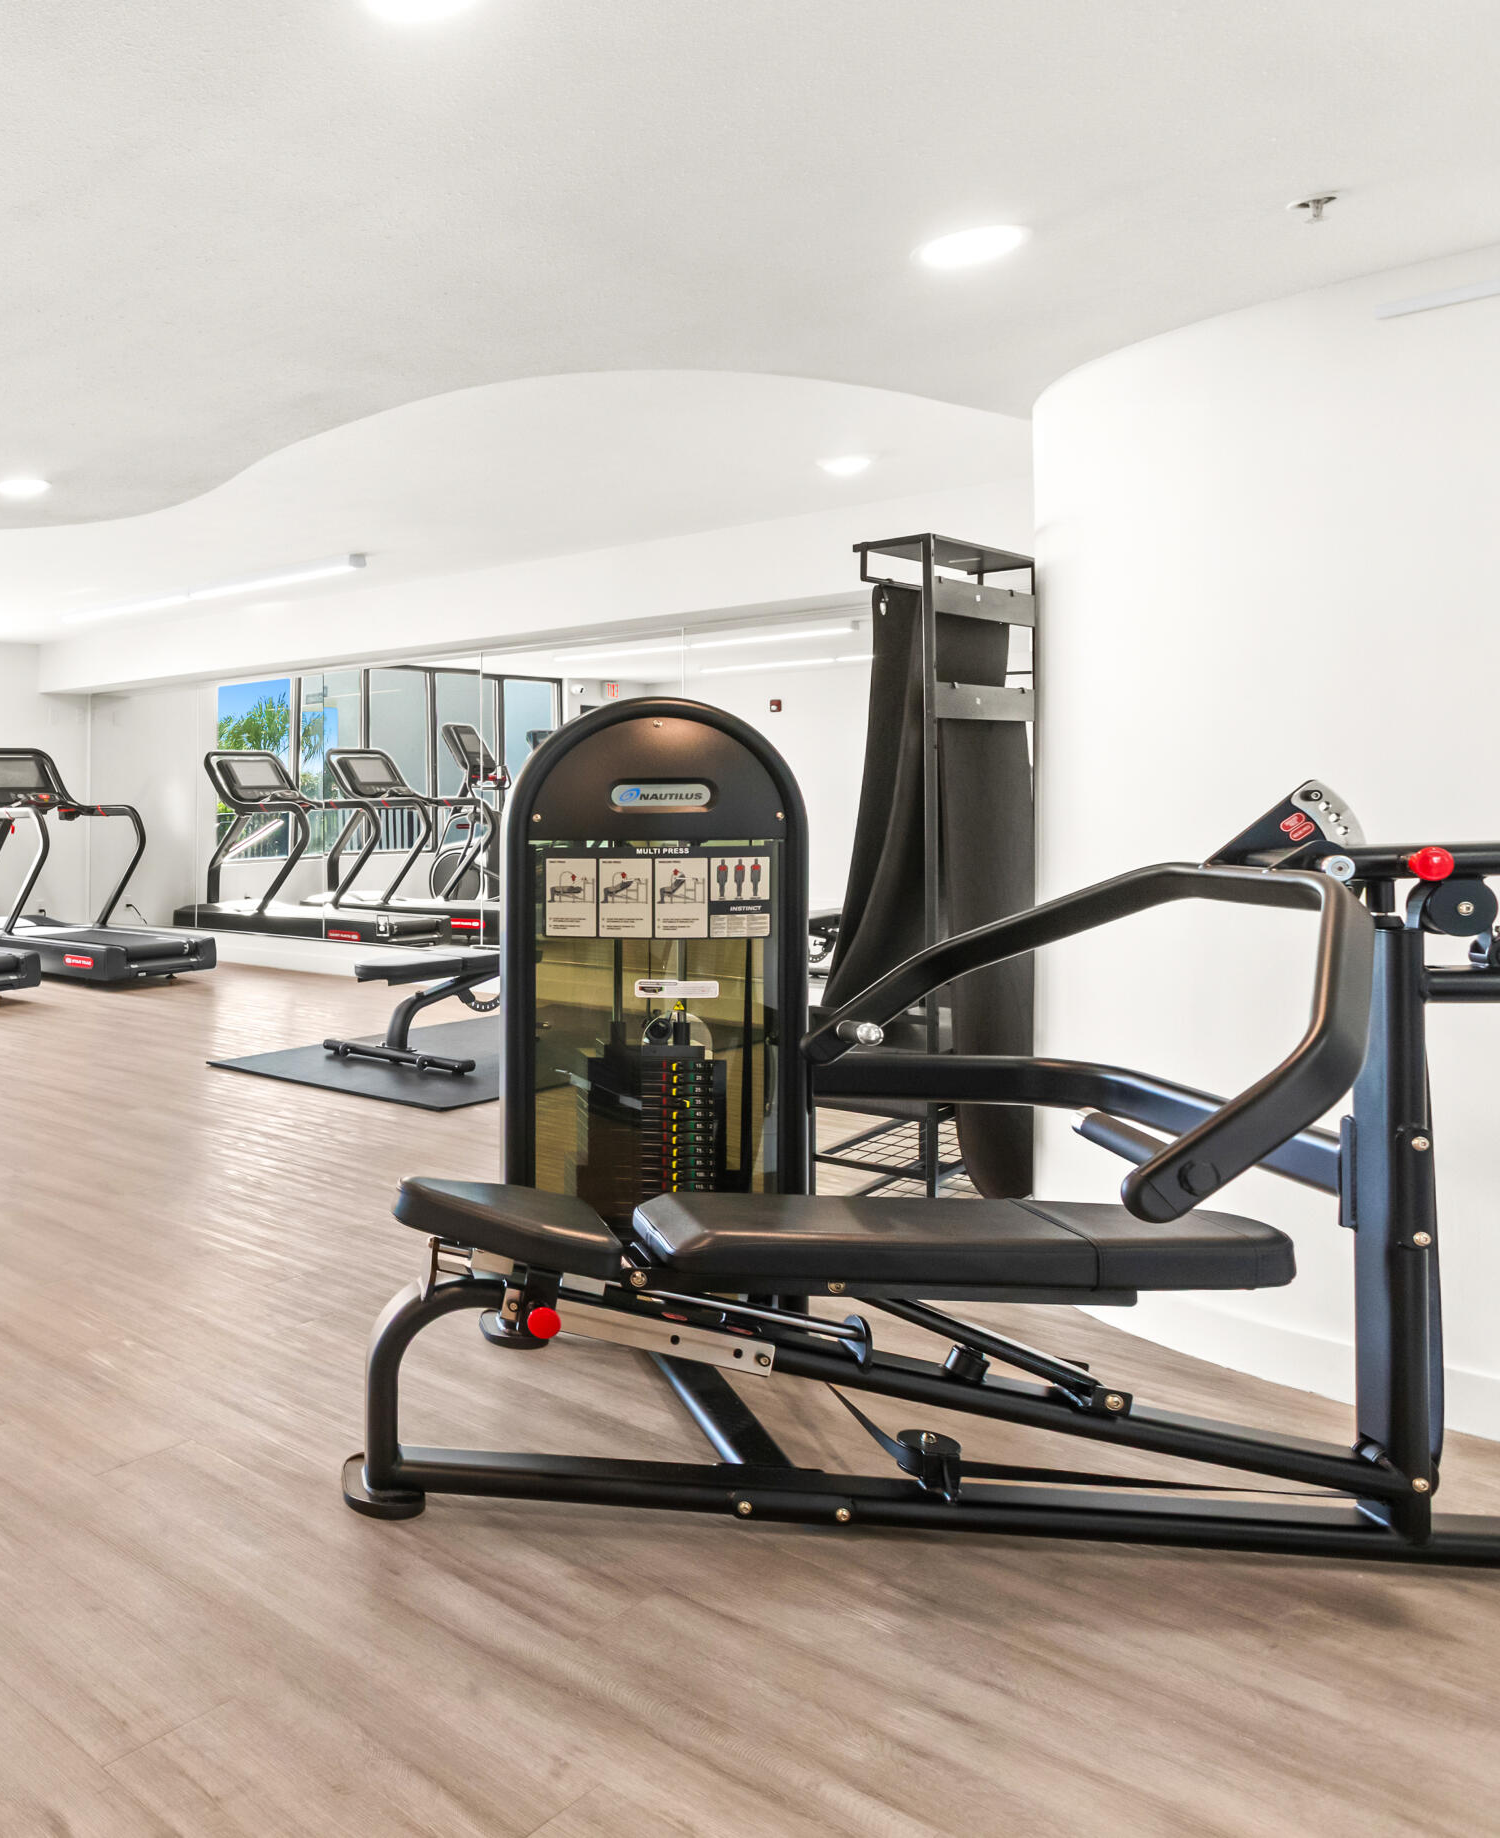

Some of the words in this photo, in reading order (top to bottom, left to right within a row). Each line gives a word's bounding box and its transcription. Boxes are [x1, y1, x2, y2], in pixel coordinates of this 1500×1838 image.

[639, 792, 703, 801] NAUTILUS
[636, 847, 661, 855] MULTI
[662, 847, 690, 855] PRESS
[730, 904, 762, 912] INSTINCT
